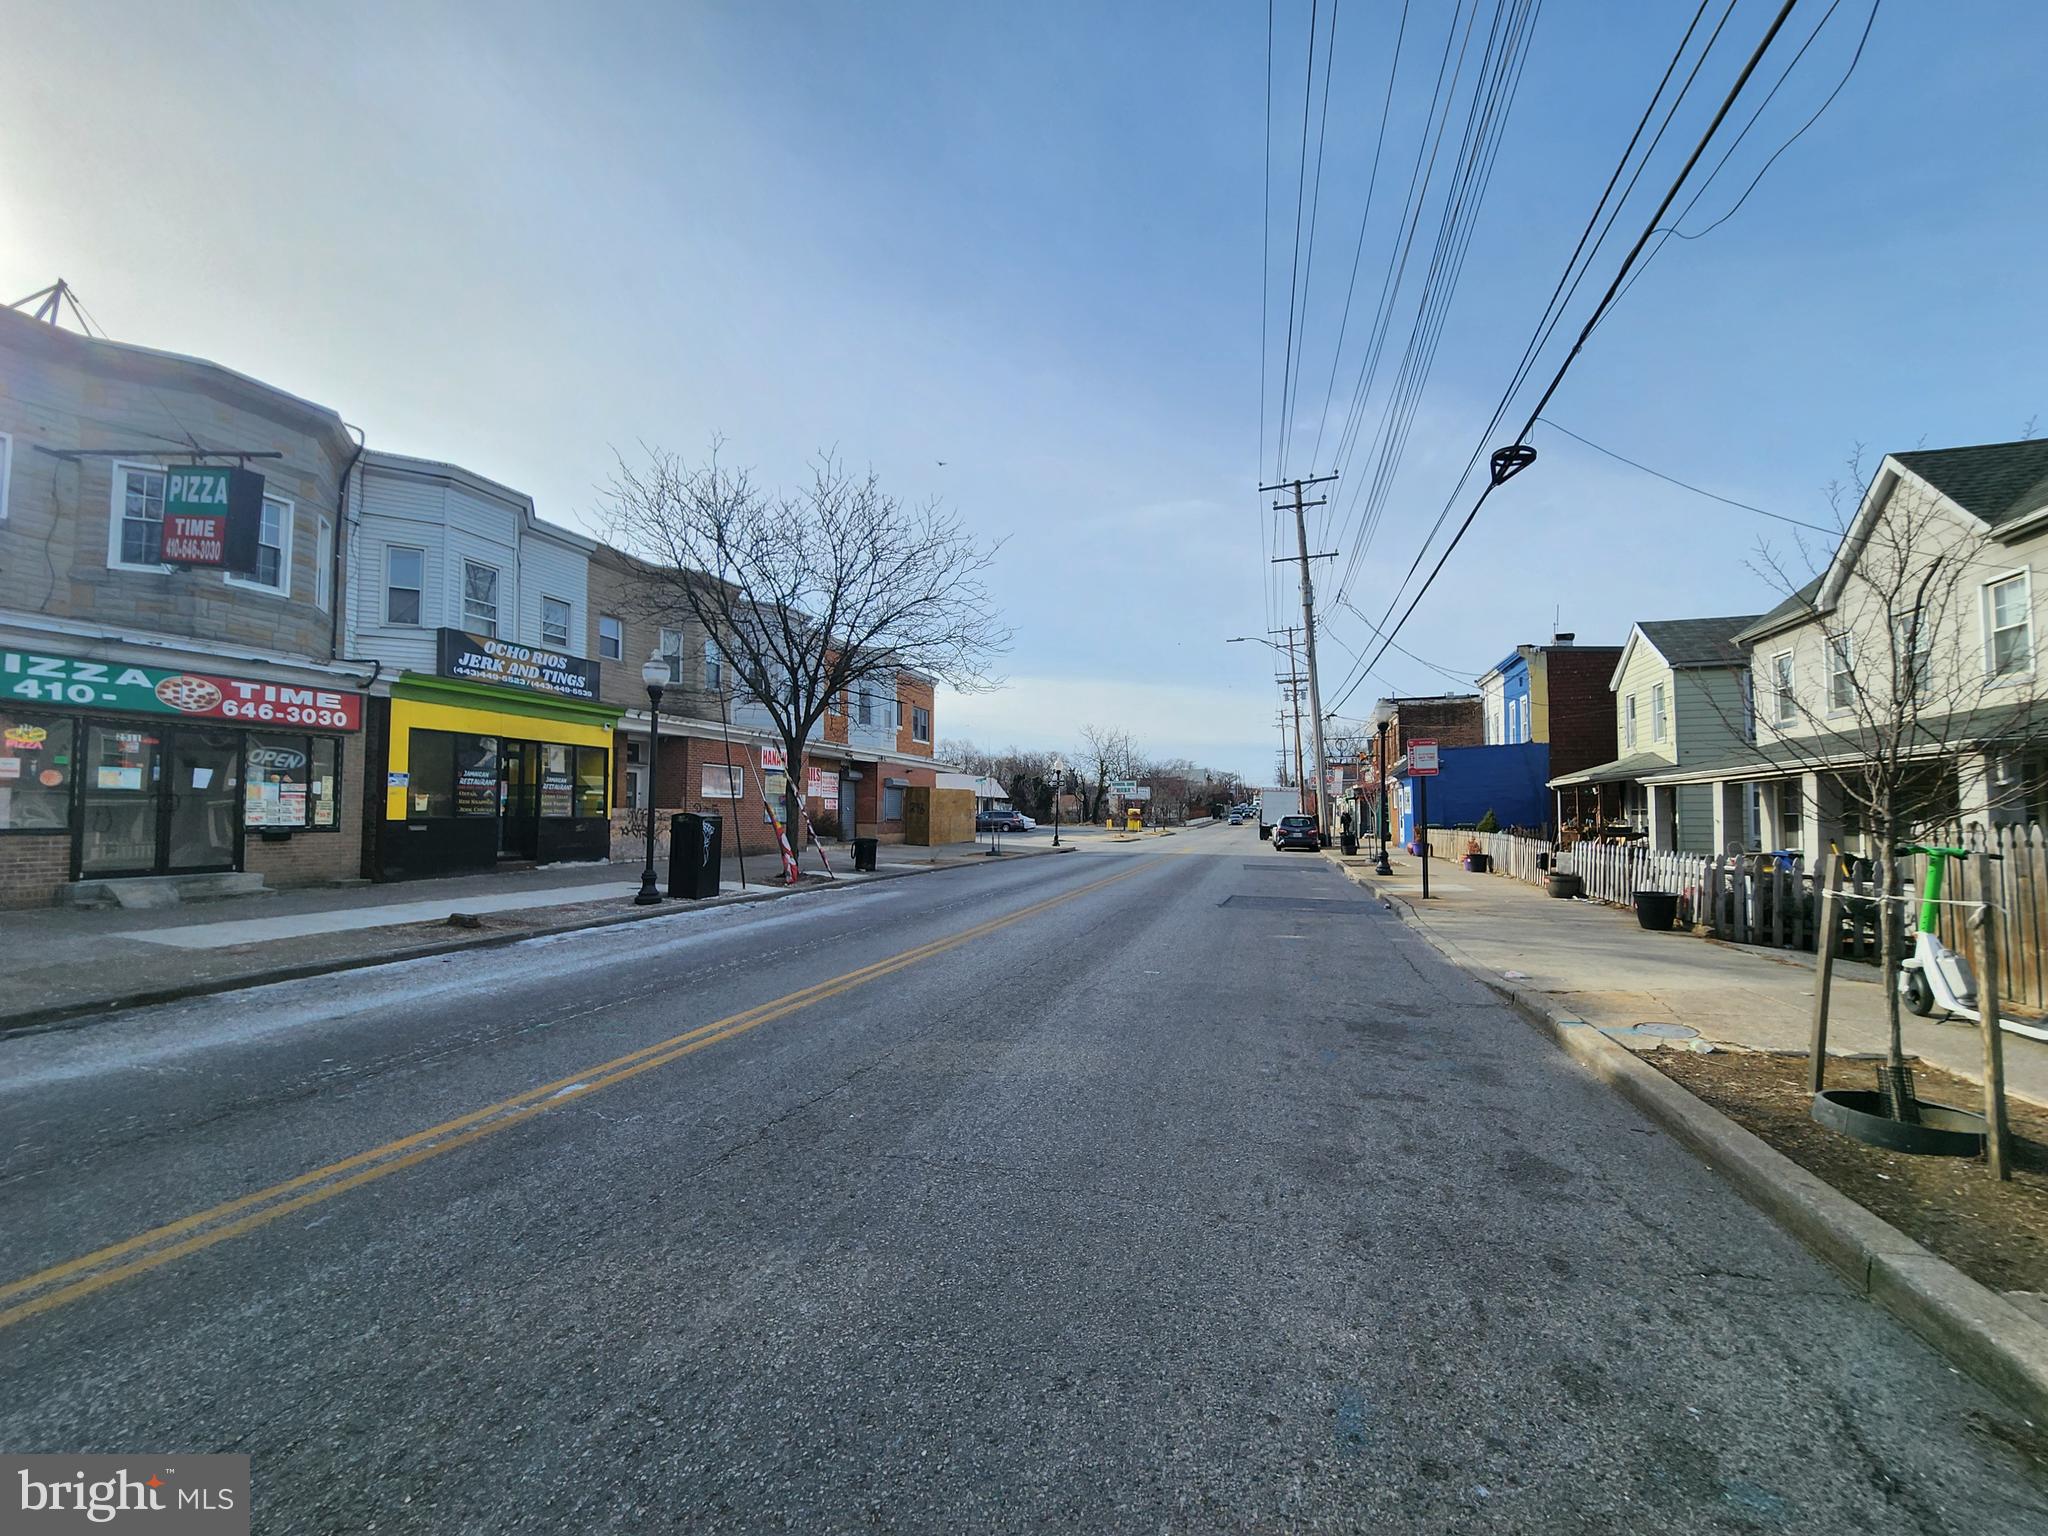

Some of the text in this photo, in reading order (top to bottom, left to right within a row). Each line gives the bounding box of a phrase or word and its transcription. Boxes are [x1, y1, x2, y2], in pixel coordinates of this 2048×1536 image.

[169, 475, 228, 504] PIZZA
[175, 518, 216, 537] TIME
[166, 538, 221, 560] 410-646-3030
[483, 640, 568, 670] OCHO RIOS
[5, 653, 154, 689] IZZA
[458, 652, 586, 688] JERK AND TINGS
[13, 678, 117, 703] 410-
[230, 681, 342, 710] TIME
[222, 699, 347, 727] 646-3030
[248, 749, 301, 769] OPEN
[458, 778, 497, 786] RESTAURANT
